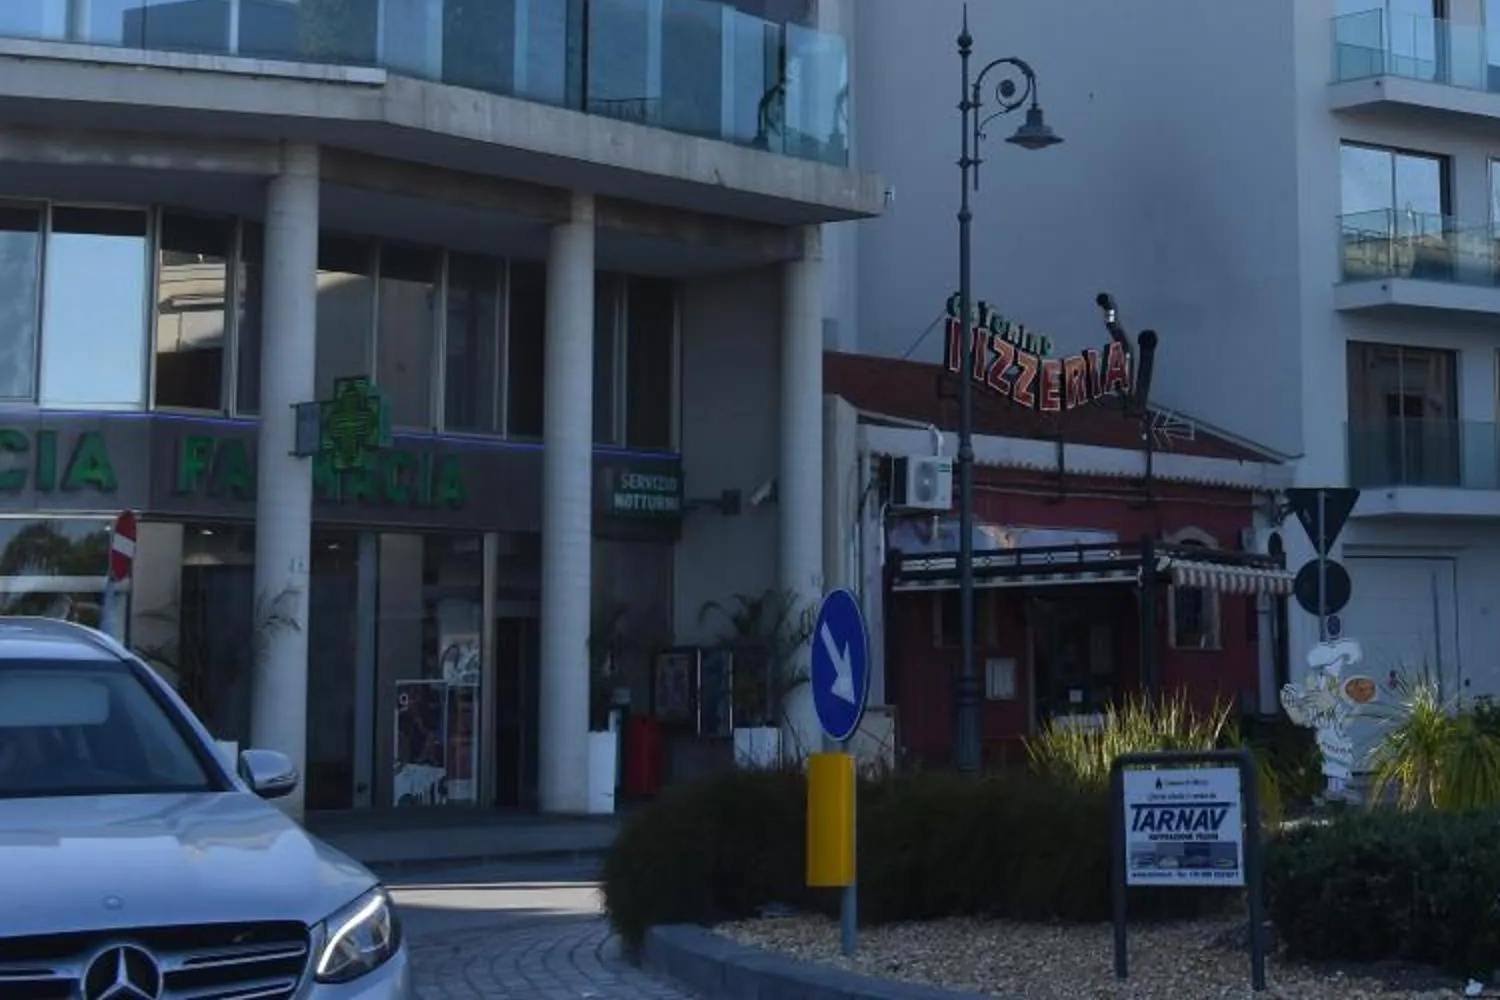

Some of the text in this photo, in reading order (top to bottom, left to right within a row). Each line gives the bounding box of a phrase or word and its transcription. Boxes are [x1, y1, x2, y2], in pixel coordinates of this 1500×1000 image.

[945, 317, 1131, 411] PIZZERIA
[176, 436, 468, 506] FAMACIA
[621, 473, 678, 491] SERVIZIO
[1130, 802, 1231, 831] TARNAV
